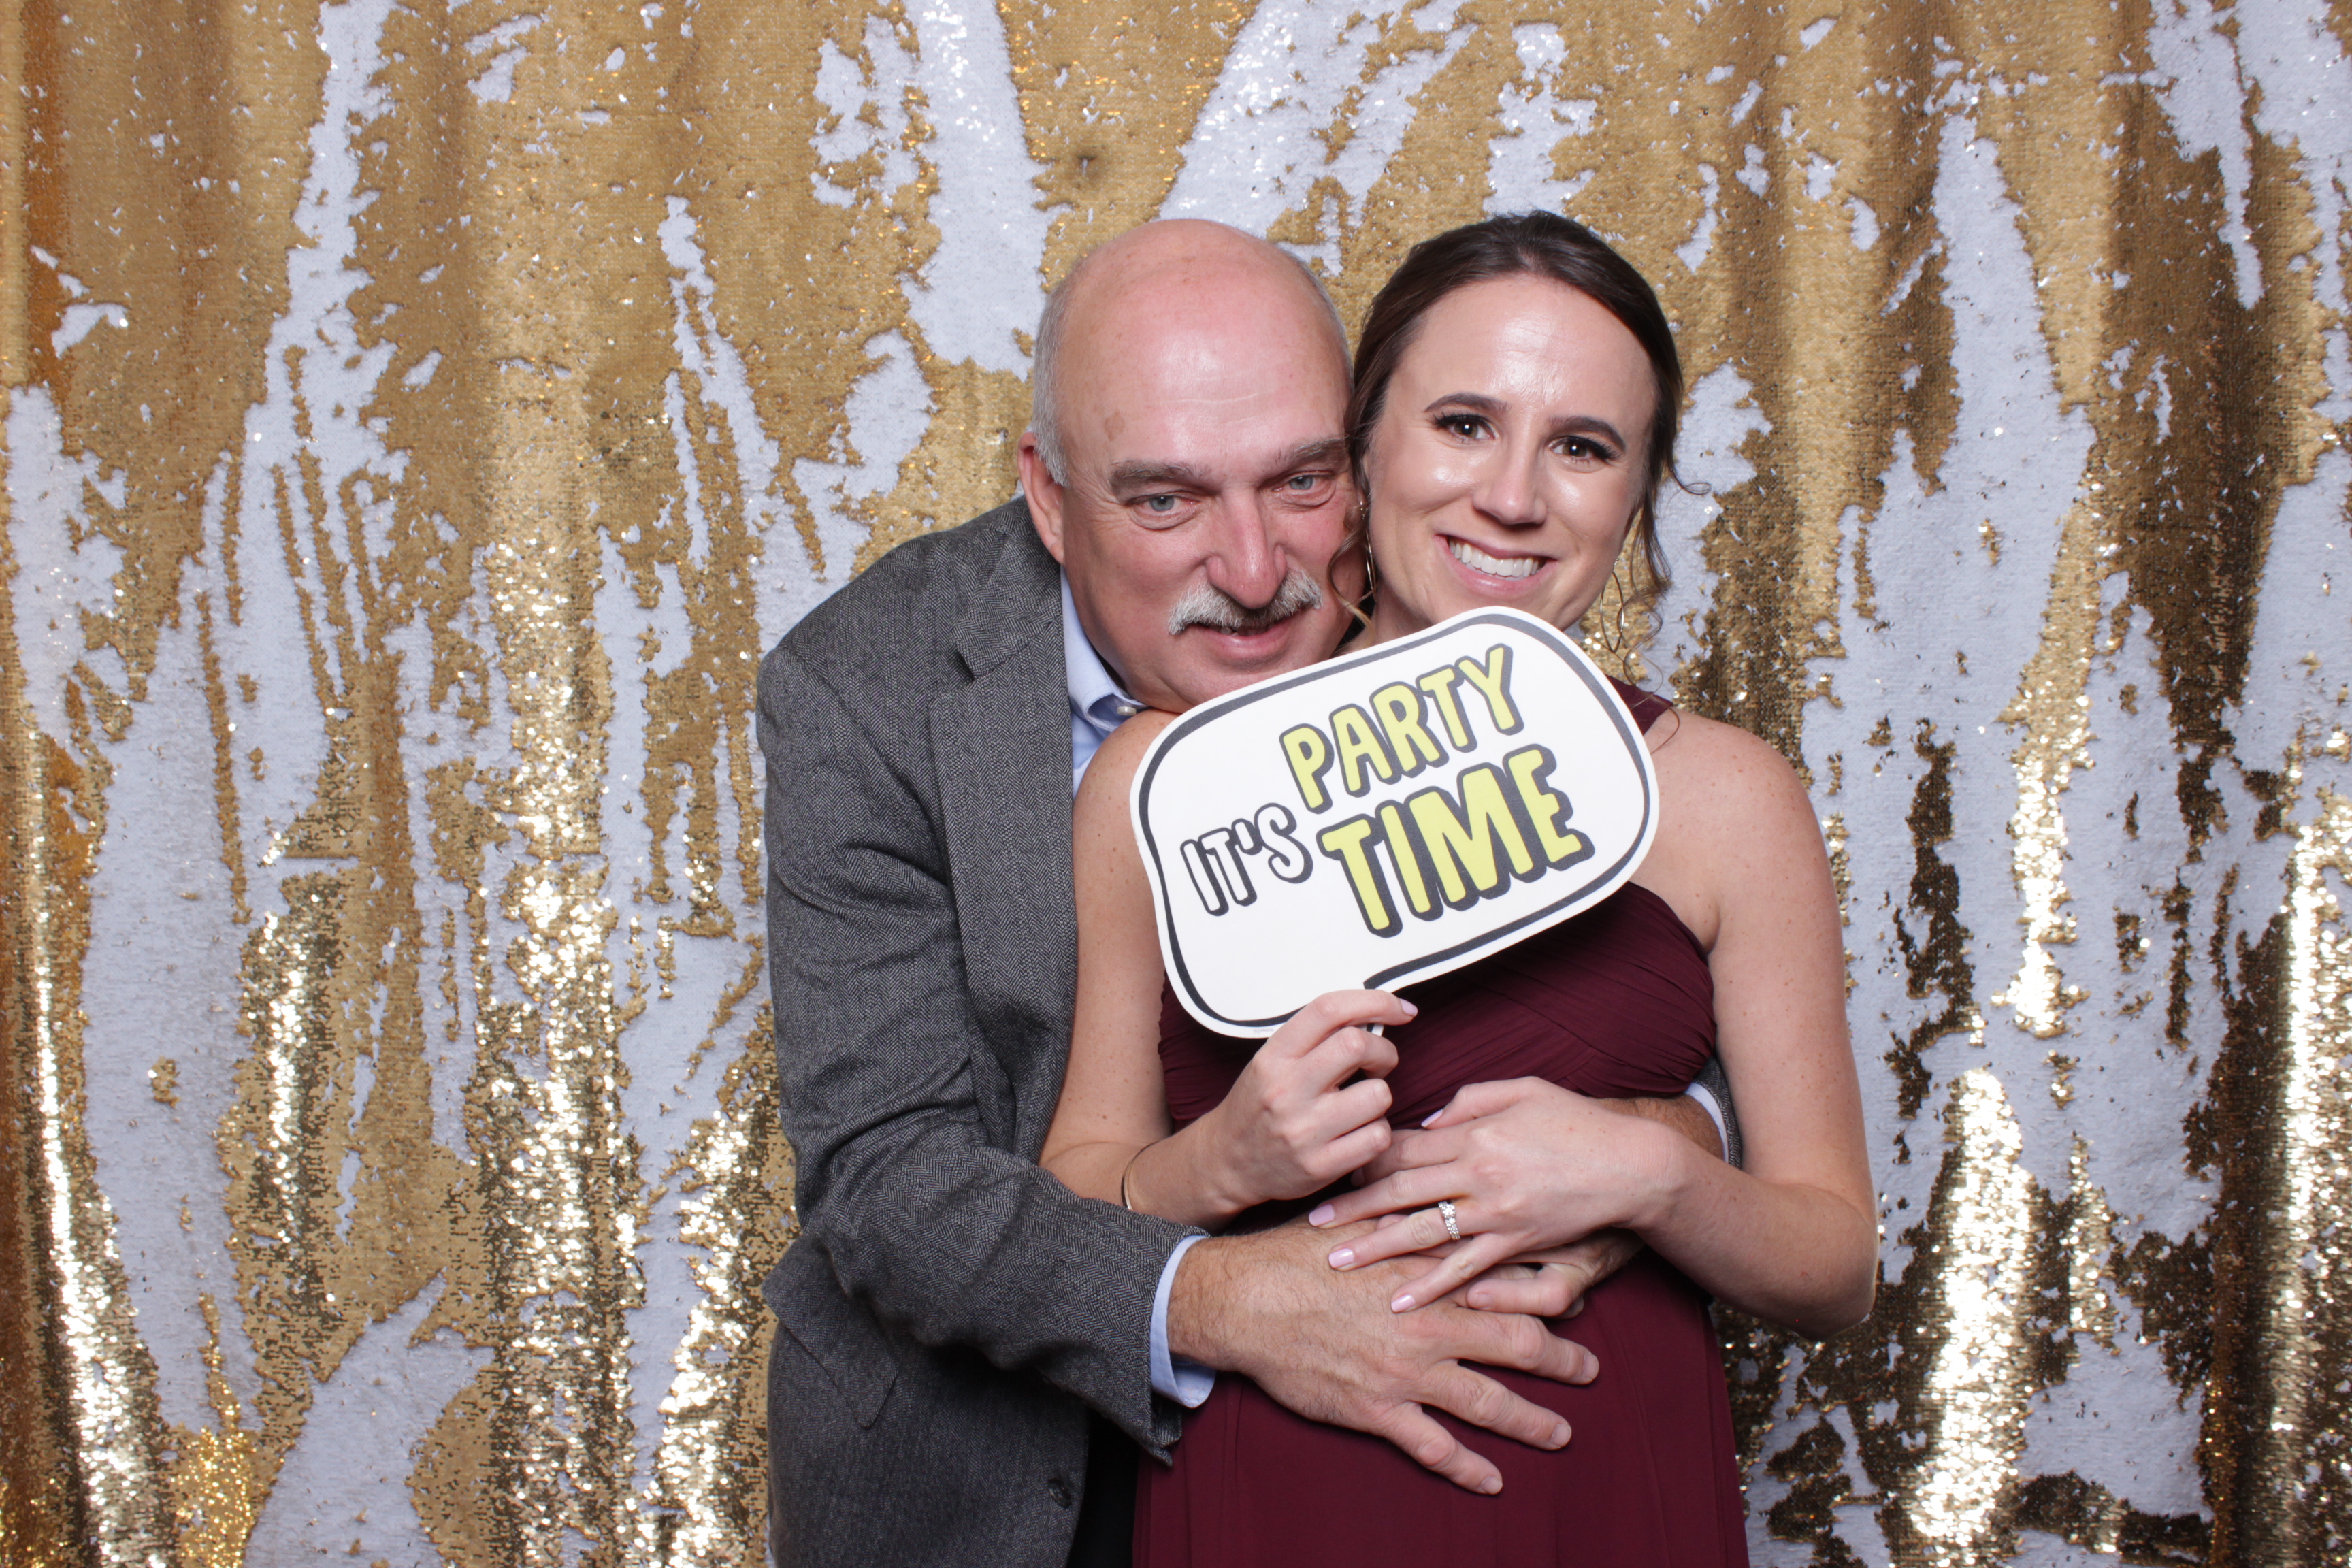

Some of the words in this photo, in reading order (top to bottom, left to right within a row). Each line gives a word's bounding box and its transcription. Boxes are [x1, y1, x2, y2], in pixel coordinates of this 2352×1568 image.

[1279, 643, 1524, 815] PARTY
[1180, 802, 1313, 917] IT'S
[1316, 743, 1595, 938] TIME
